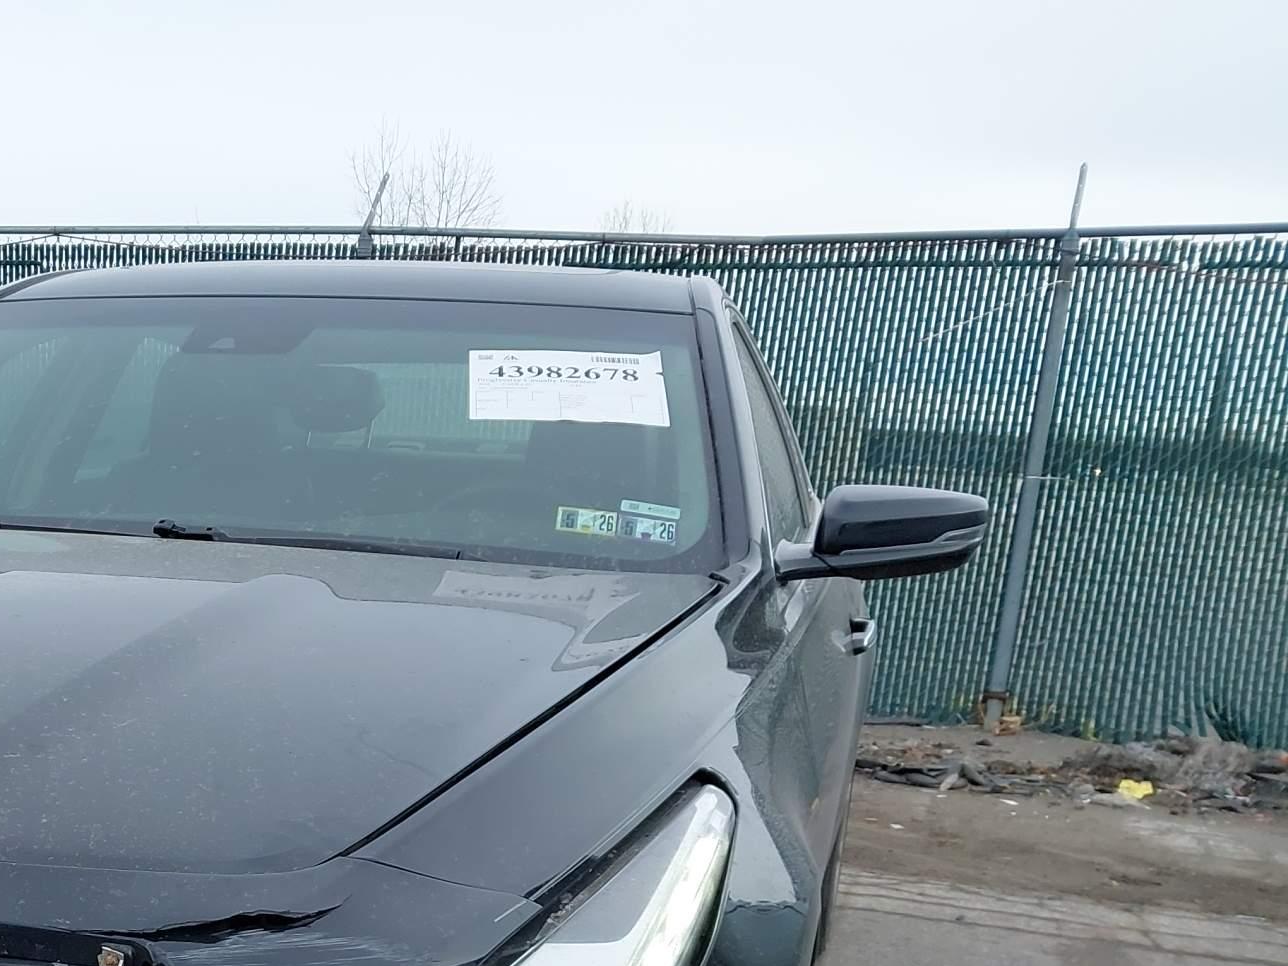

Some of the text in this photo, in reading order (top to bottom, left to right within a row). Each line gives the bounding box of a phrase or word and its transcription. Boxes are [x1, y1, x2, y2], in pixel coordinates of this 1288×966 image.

[488, 365, 640, 382] 43982678
[599, 514, 615, 532] 26
[659, 522, 675, 541] 26
